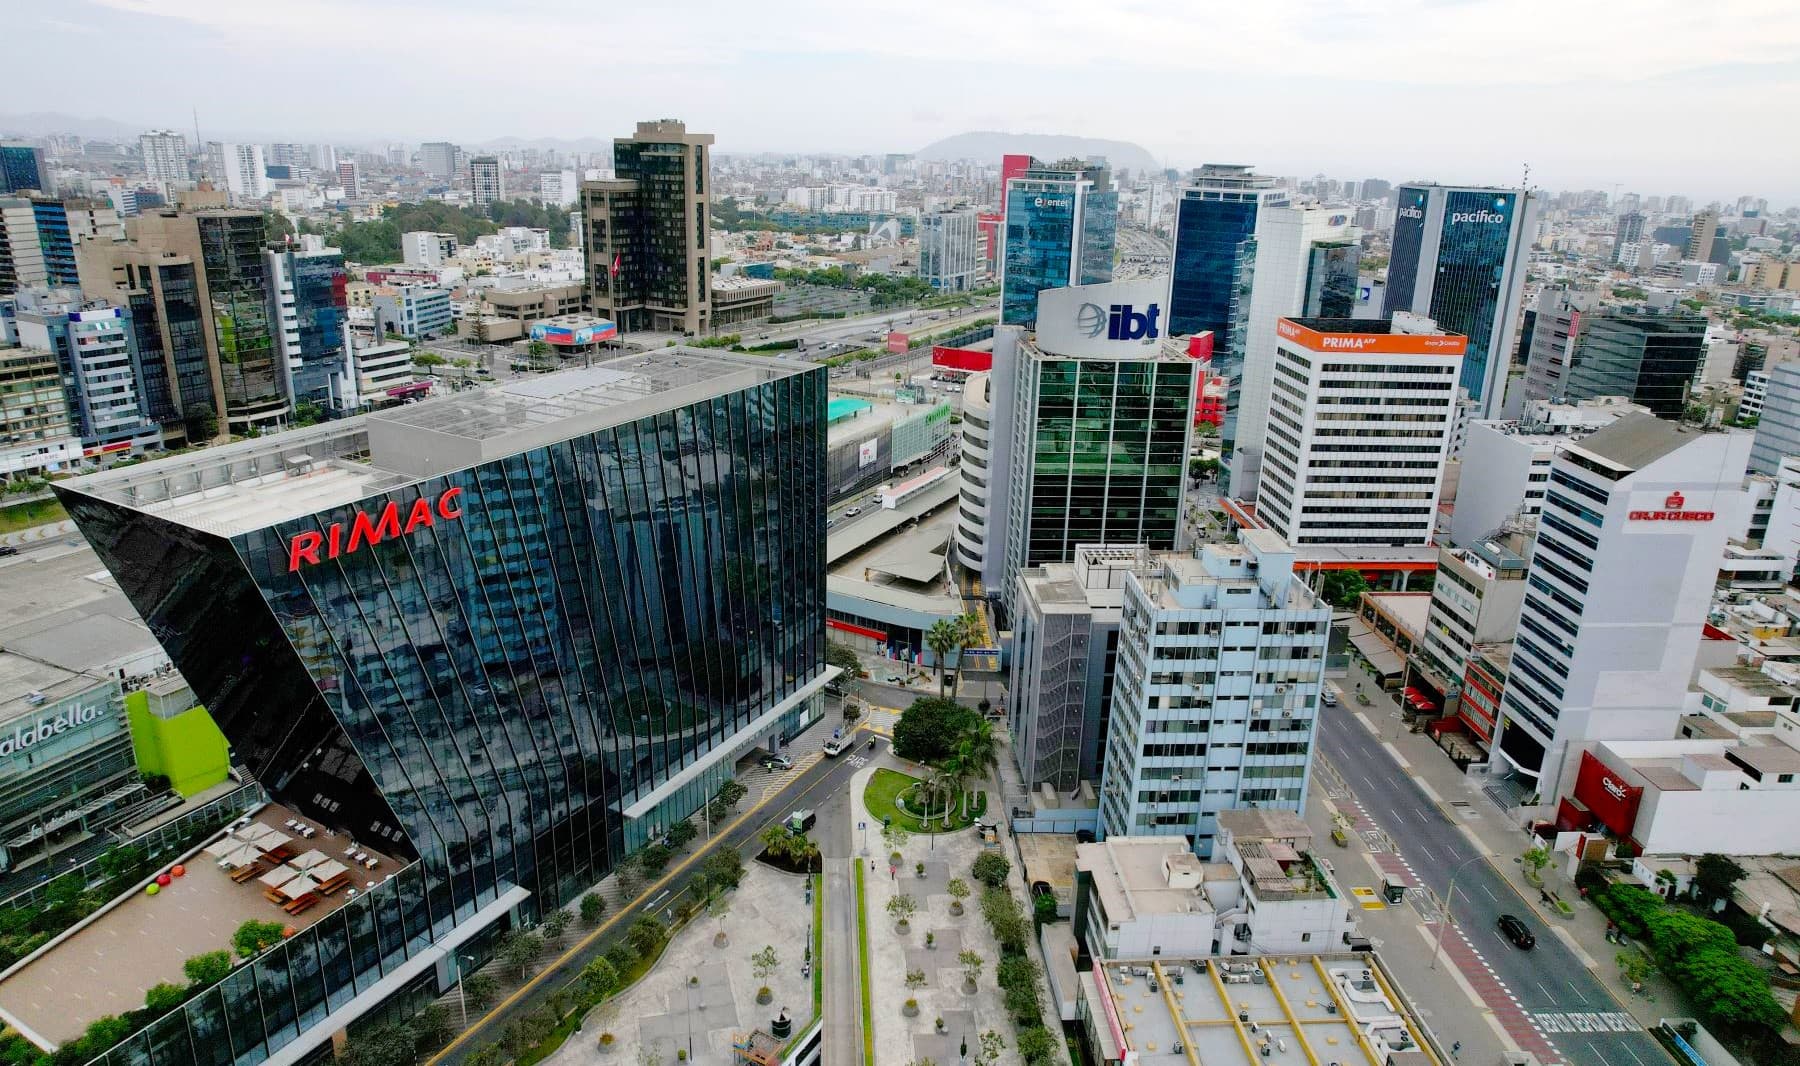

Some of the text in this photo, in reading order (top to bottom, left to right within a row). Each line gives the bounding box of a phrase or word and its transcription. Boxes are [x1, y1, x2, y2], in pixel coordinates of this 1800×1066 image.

[1108, 303, 1160, 341] ibt
[1323, 336, 1363, 349] PRIMA
[289, 487, 463, 573] RIMAC
[1602, 777, 1622, 797] Claro
